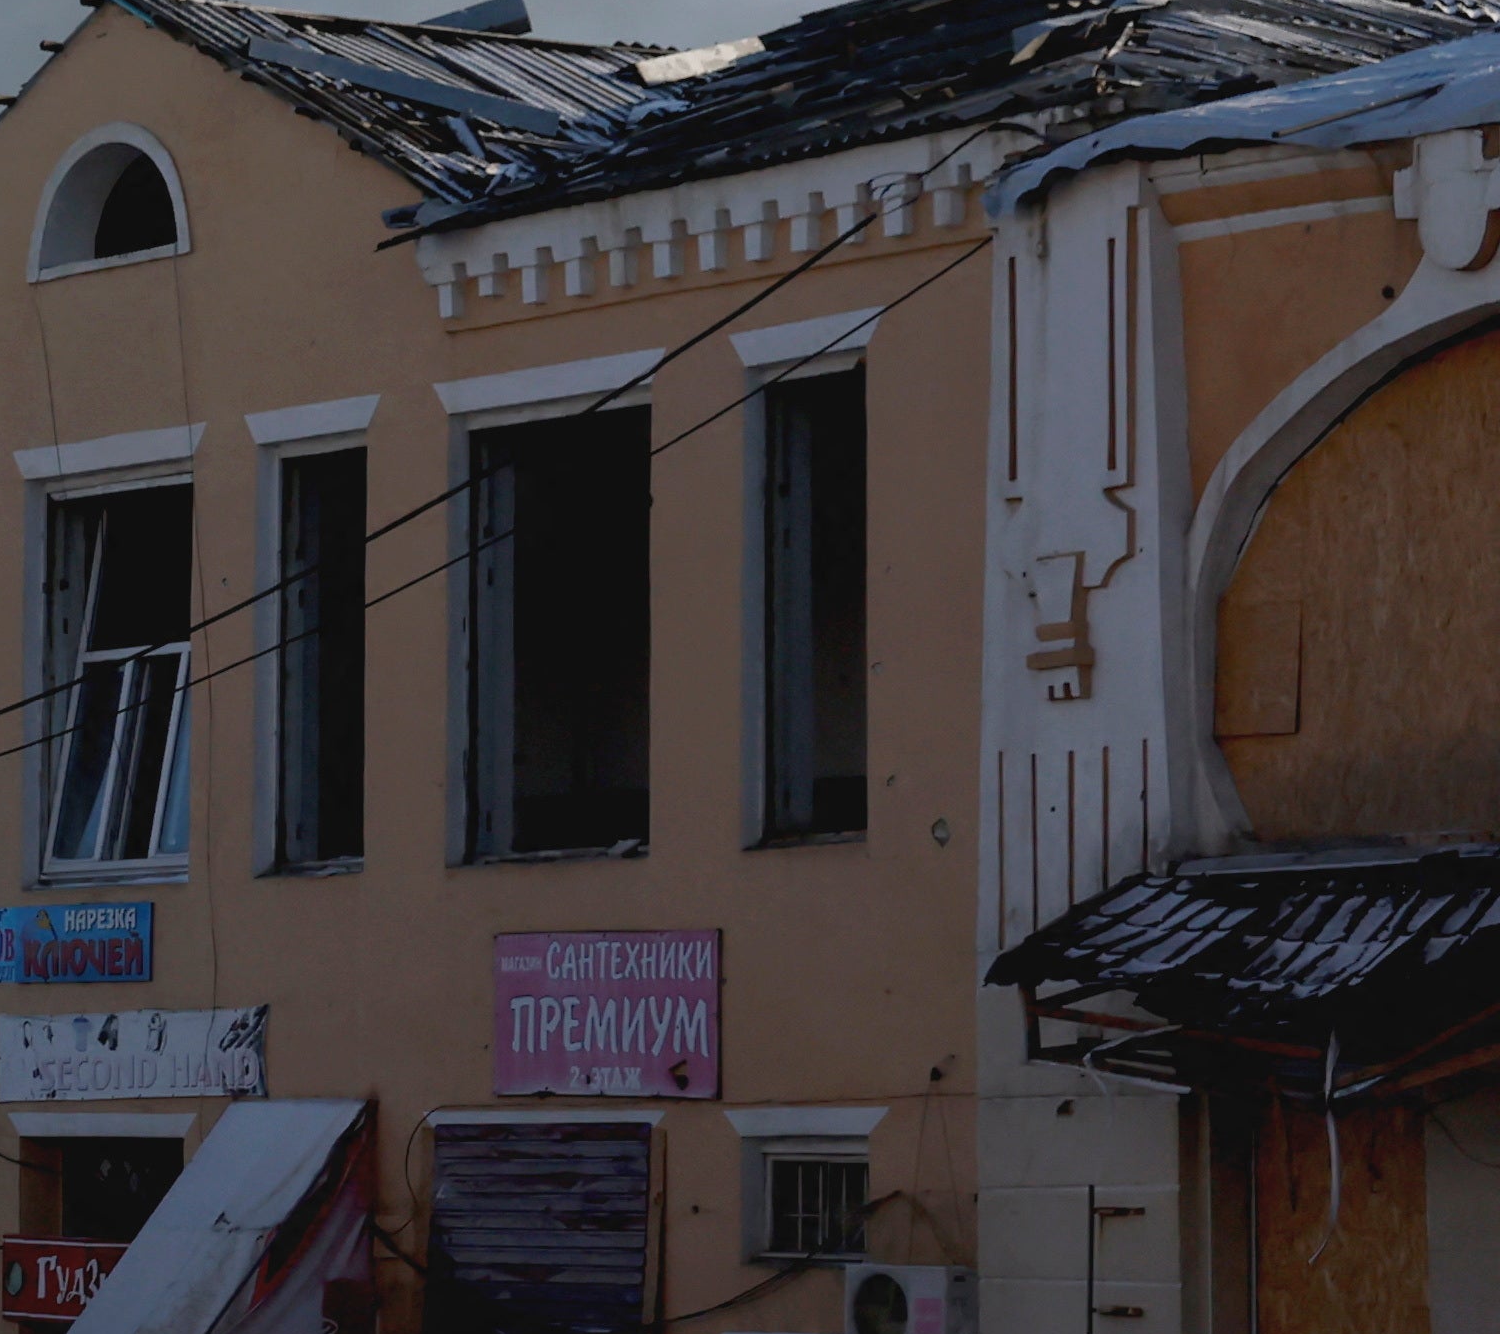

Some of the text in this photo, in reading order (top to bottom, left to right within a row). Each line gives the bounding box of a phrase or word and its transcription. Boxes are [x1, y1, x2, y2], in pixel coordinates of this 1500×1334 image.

[64, 907, 138, 933] НАРЕЗКА
[22, 930, 145, 980] КЛЮЧЕЙ
[500, 939, 713, 982] МАГАЗИН САНТЕХНИКИ
[509, 994, 710, 1058] ПРЕМИУМ
[40, 1047, 260, 1091] SECOND HAND
